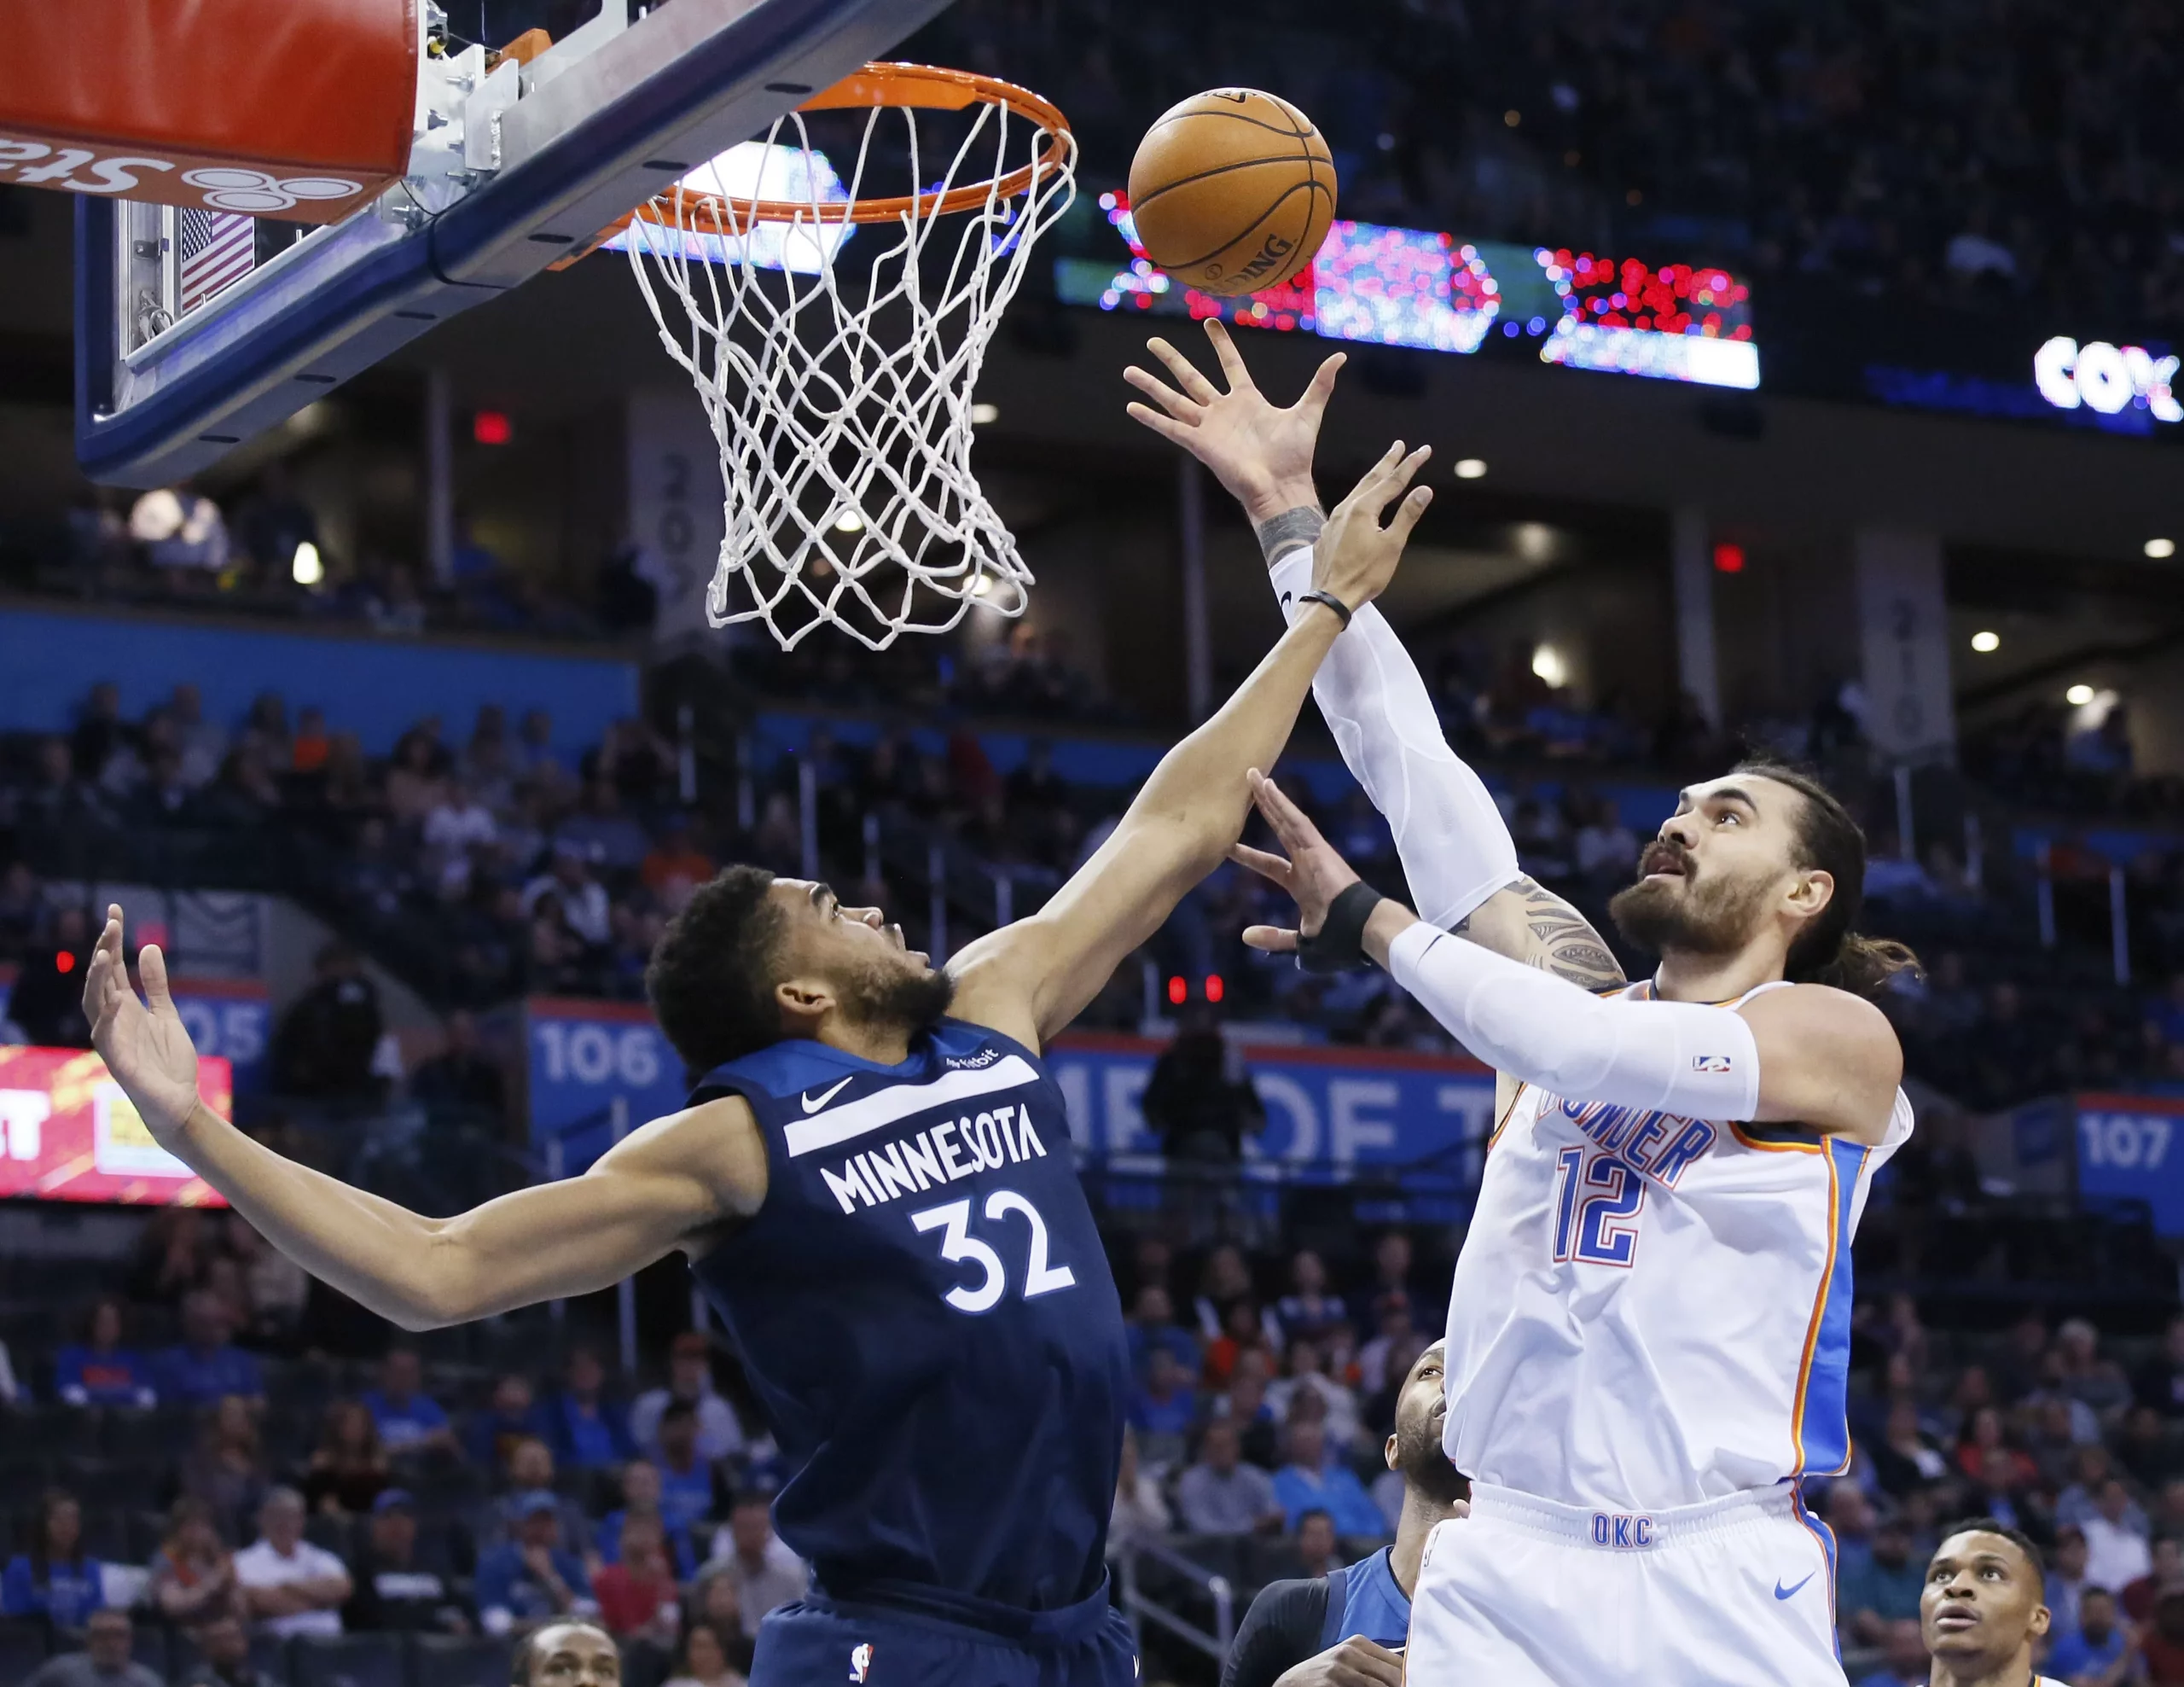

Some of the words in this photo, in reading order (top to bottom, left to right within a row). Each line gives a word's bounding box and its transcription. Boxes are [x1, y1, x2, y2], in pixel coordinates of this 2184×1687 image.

[2034, 335, 2183, 422] COX
[180, 1002, 265, 1062] 05
[539, 1024, 659, 1087] 106
[820, 1103, 1047, 1214] MINNESOTA
[2082, 1114, 2172, 1170] 107
[1553, 1146, 1647, 1269] 12
[910, 1190, 1076, 1312] 32
[1592, 1513, 1653, 1548] OKC
